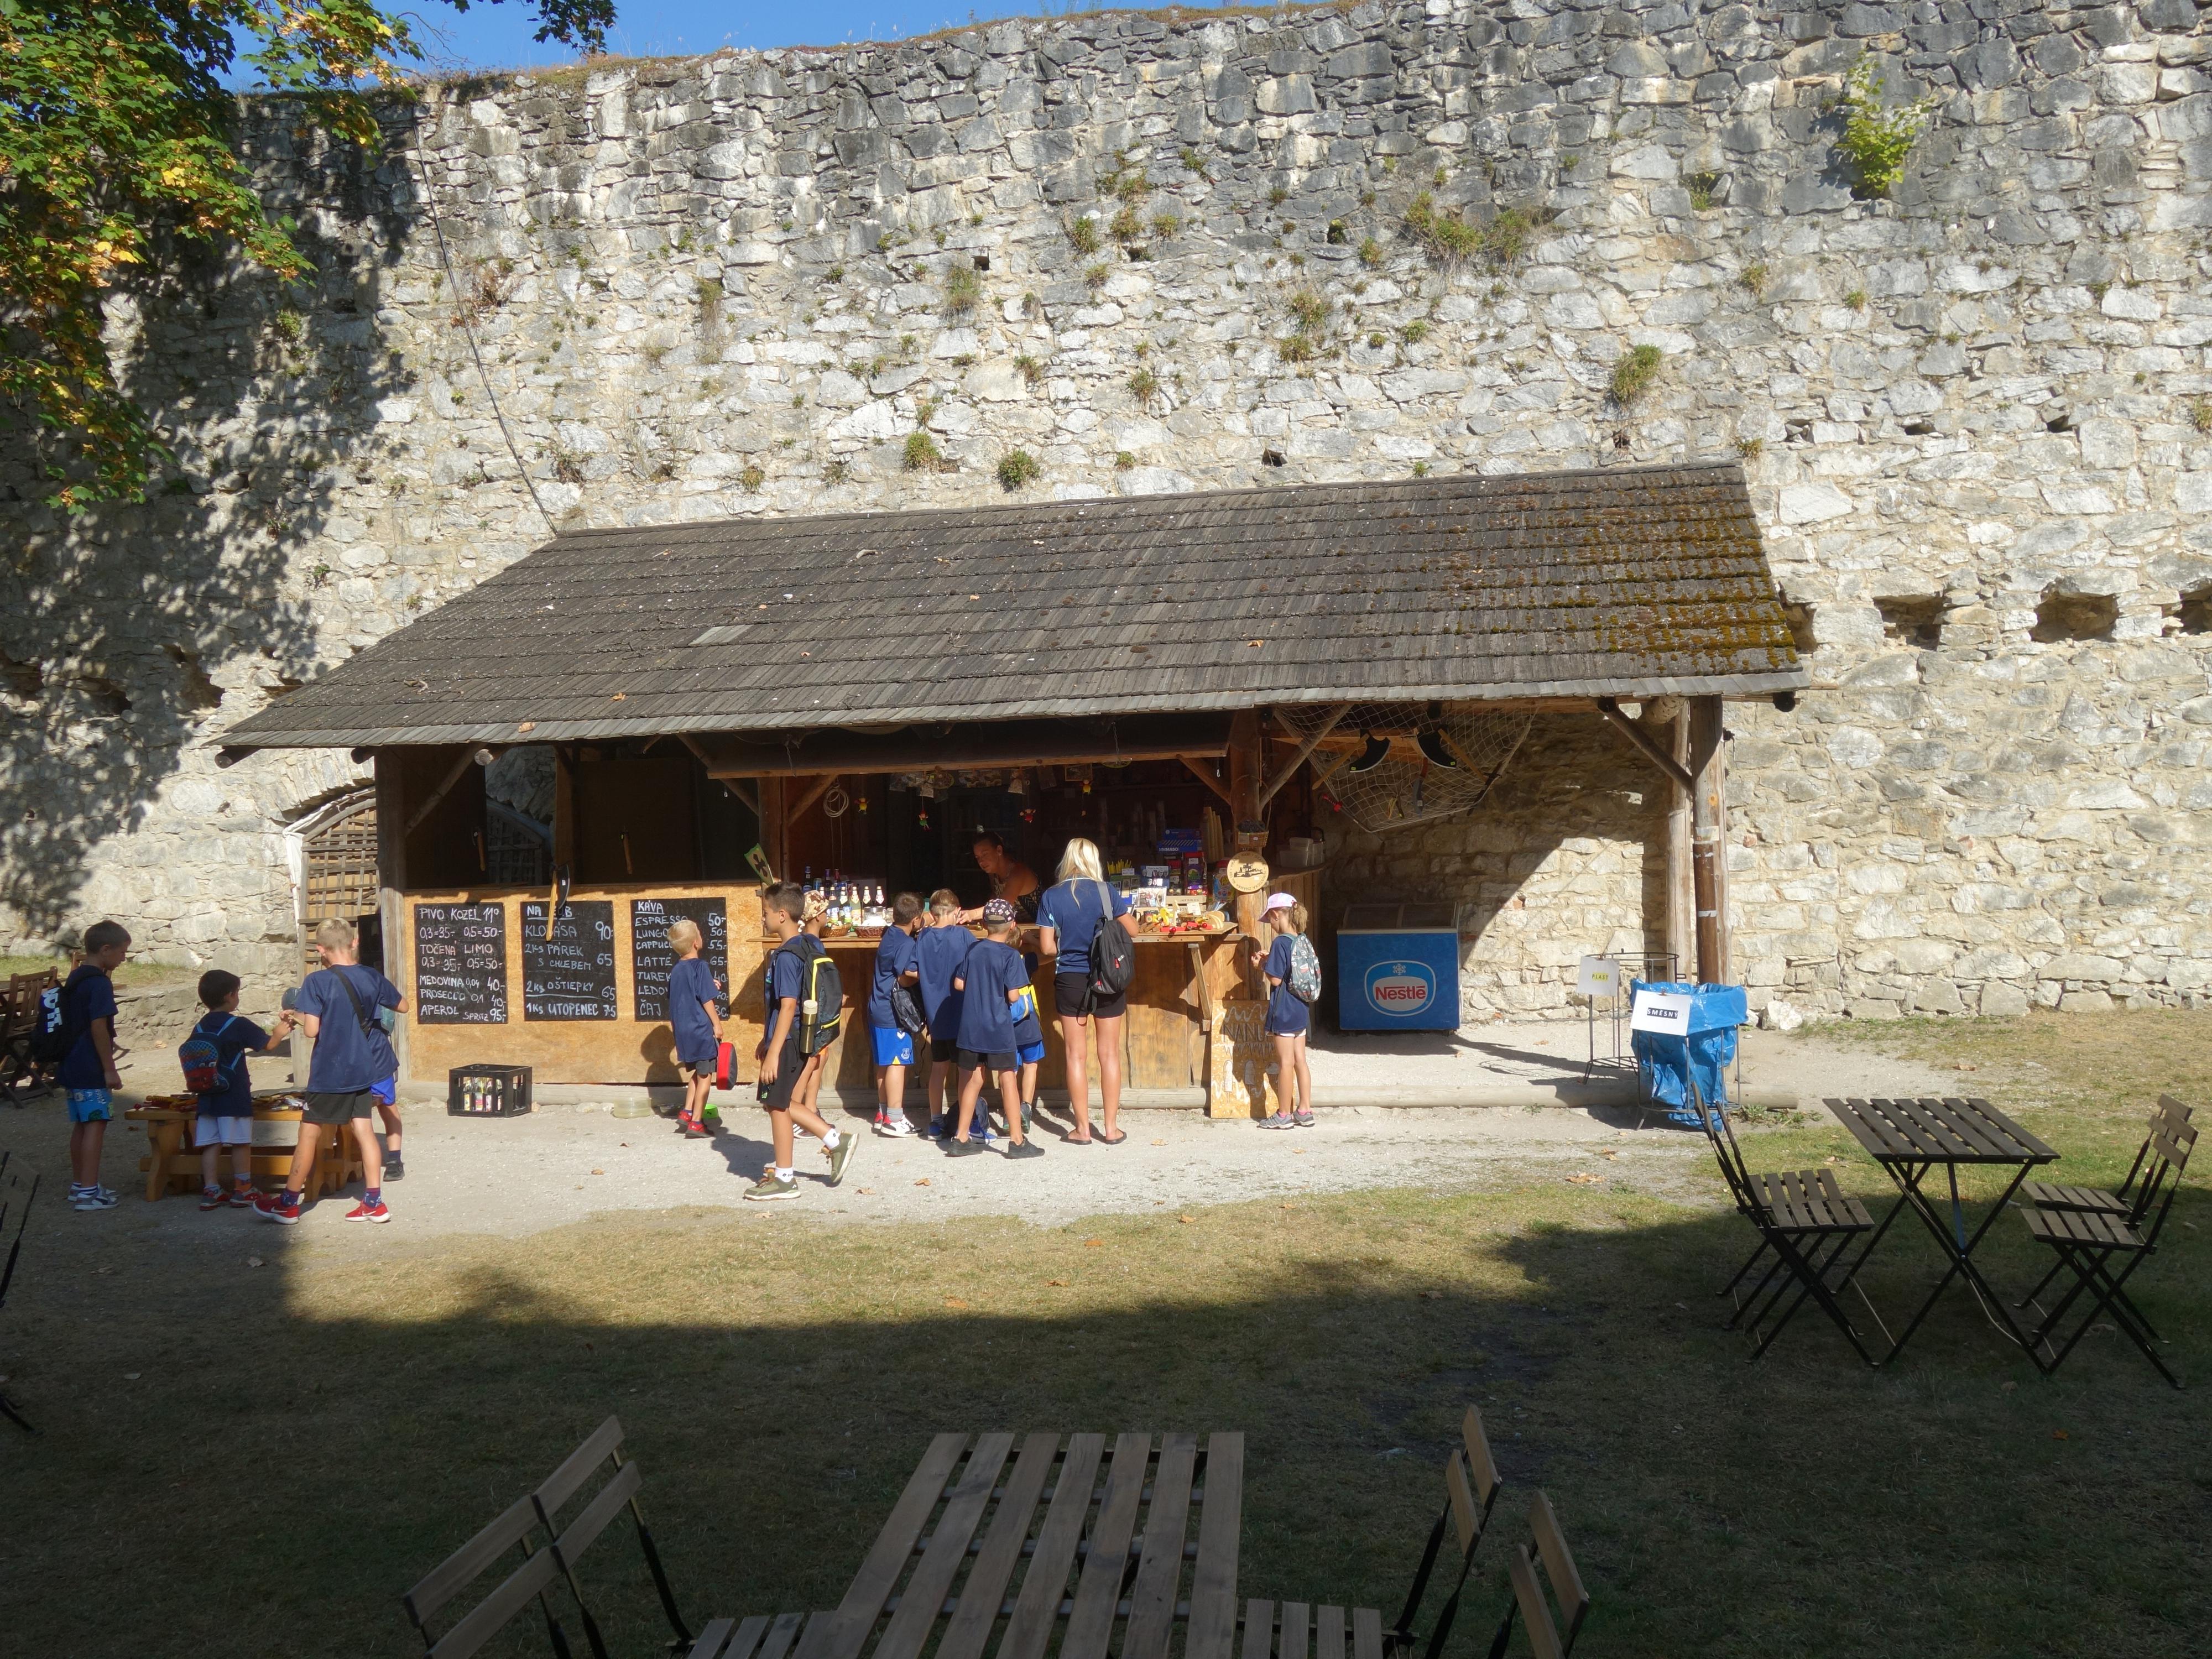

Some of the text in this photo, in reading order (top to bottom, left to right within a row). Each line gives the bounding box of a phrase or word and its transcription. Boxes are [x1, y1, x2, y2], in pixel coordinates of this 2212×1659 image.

[526, 905, 542, 916] NA
[638, 900, 664, 913] KÁVA
[419, 908, 445, 920] PIVO
[451, 907, 482, 921] KOZEL
[525, 921, 577, 937] KLOÁSA
[464, 943, 493, 954] LIMO
[546, 942, 583, 956] PÁREK
[550, 959, 591, 971] CHLEBEM
[597, 953, 613, 966] 65
[637, 953, 672, 967] LATTÉ
[419, 975, 464, 988] MEDOVINA
[637, 972, 671, 982] TUREK
[547, 977, 593, 992] OŠTIEPKY
[602, 985, 615, 1000] 65
[1375, 985, 1426, 1000] Nestlé
[420, 1004, 459, 1016] APEROL
[548, 1003, 598, 1017] UTOPENEC
[602, 1004, 616, 1018] 75
[640, 999, 661, 1016] ČAJ
[1647, 1008, 1678, 1018] SMĚSNÝ
[1222, 1022, 1268, 1043] NANU
